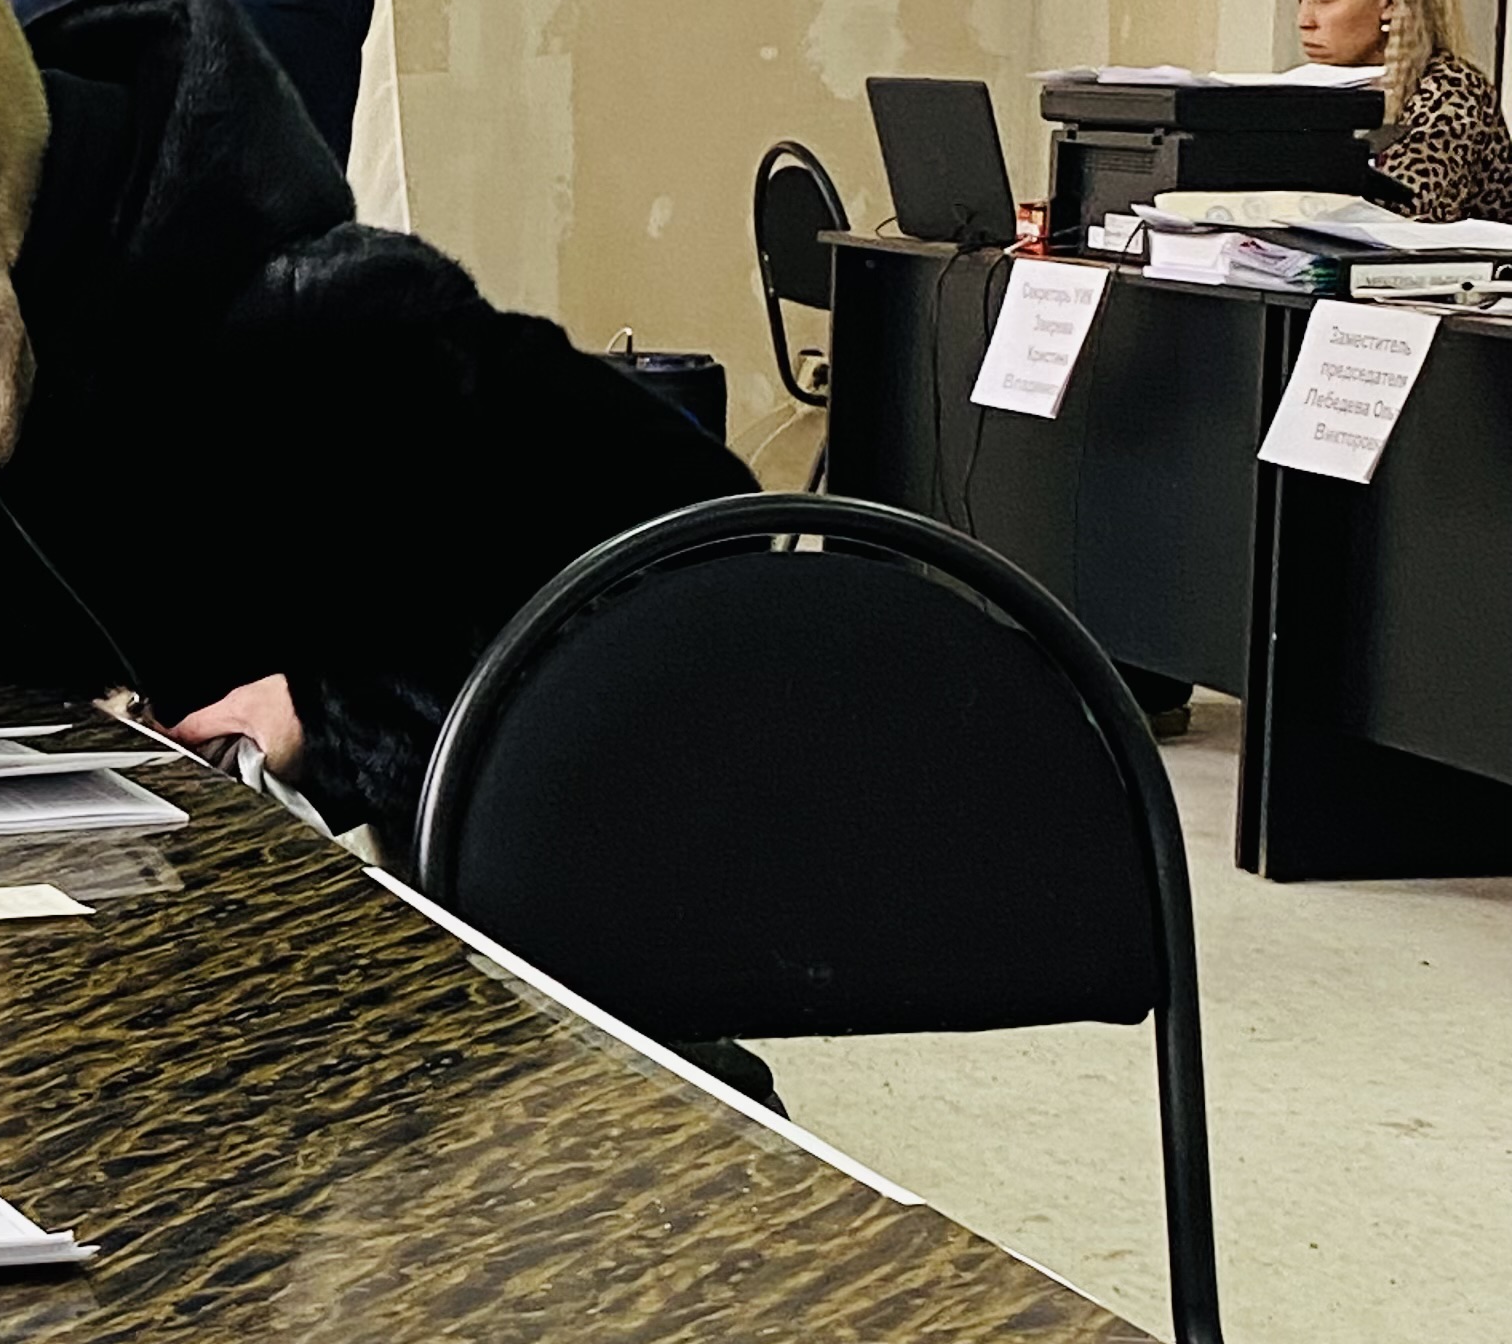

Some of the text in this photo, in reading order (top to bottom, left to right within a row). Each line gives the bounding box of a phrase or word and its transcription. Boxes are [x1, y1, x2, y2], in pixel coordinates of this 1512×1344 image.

[1330, 325, 1412, 356] Заместитель
[1320, 362, 1408, 388] председателя
[1304, 387, 1370, 417] Лебедева
